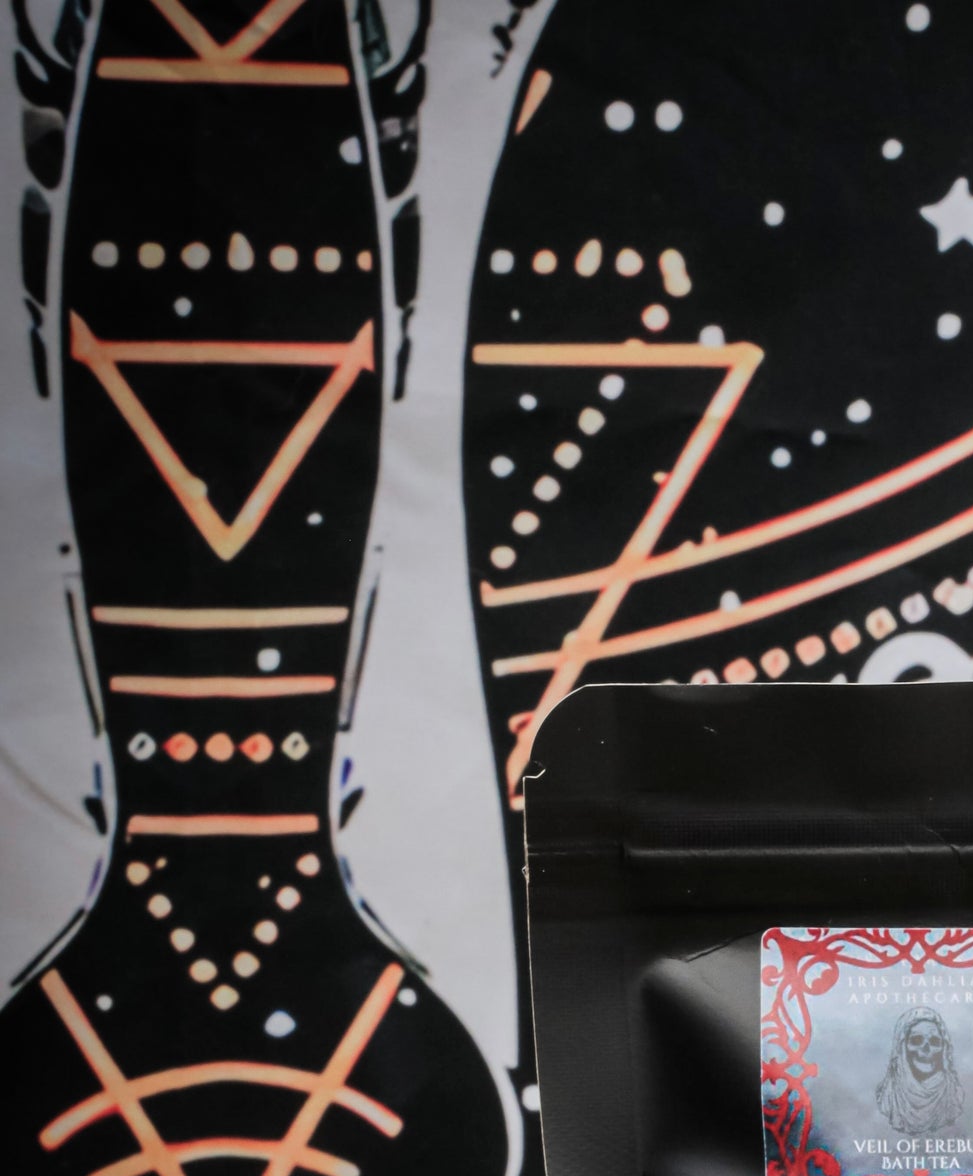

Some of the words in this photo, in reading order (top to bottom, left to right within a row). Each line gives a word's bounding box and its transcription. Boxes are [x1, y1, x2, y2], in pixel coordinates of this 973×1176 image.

[848, 976, 889, 987] IRIS
[854, 1140, 891, 1153] VEIL
[896, 1140, 921, 1153] OF
[882, 1157, 925, 1170] BATH
[928, 1157, 961, 1170] TEA
